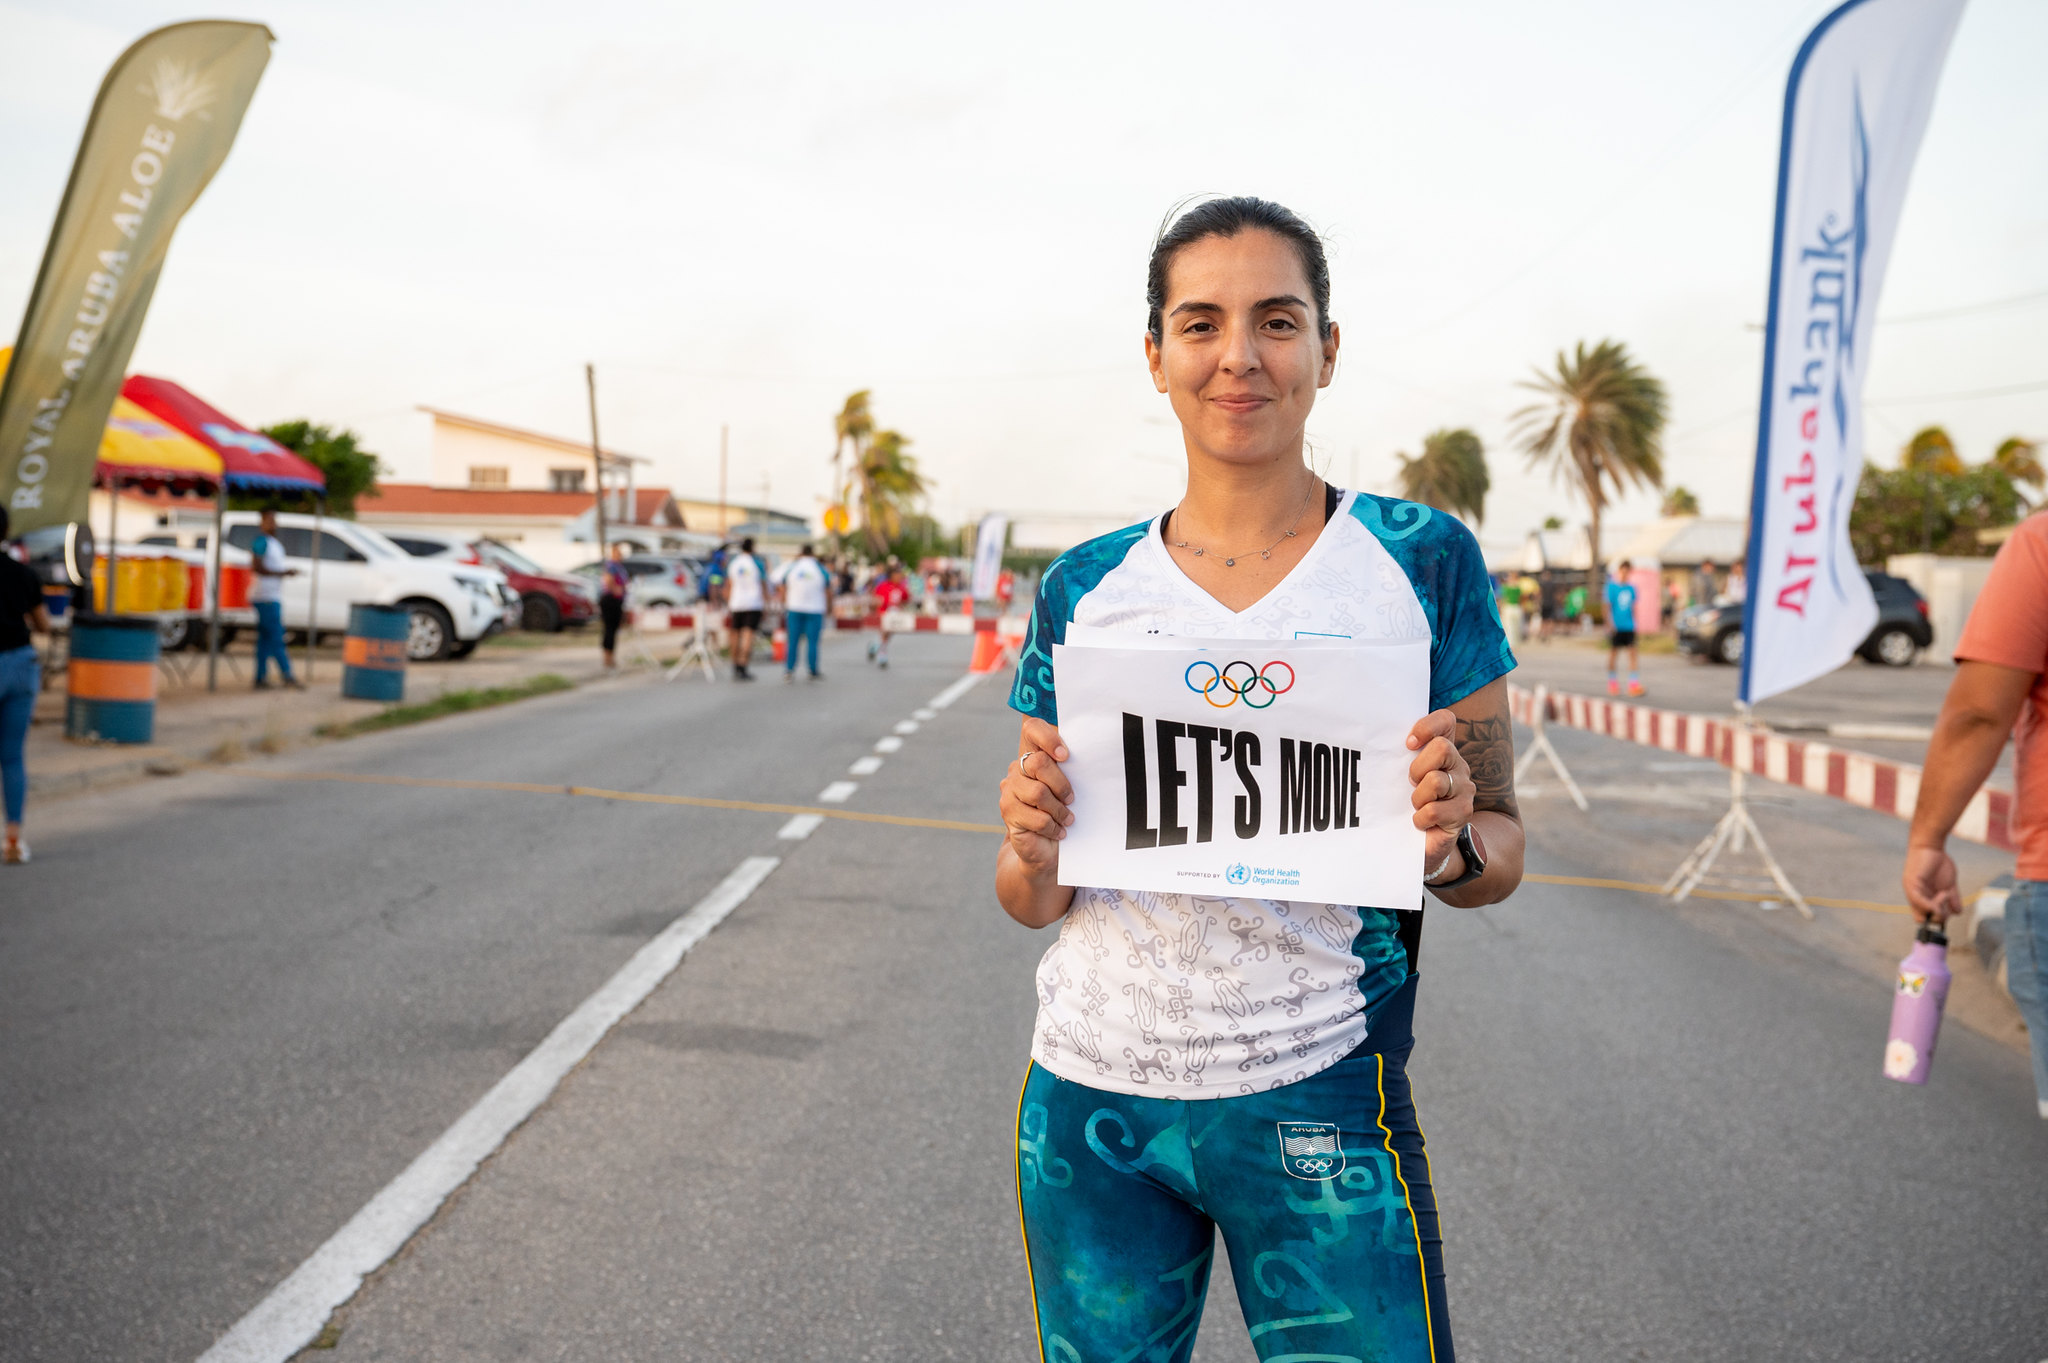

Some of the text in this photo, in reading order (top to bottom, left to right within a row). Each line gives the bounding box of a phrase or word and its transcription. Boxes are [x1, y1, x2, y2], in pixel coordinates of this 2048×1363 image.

[10, 123, 176, 510] ROYAL ARUBA ALOE
[1122, 711, 1361, 850] LET'S MOVE
[1252, 875, 1300, 886] Organization
[1253, 867, 1300, 877] World Health
